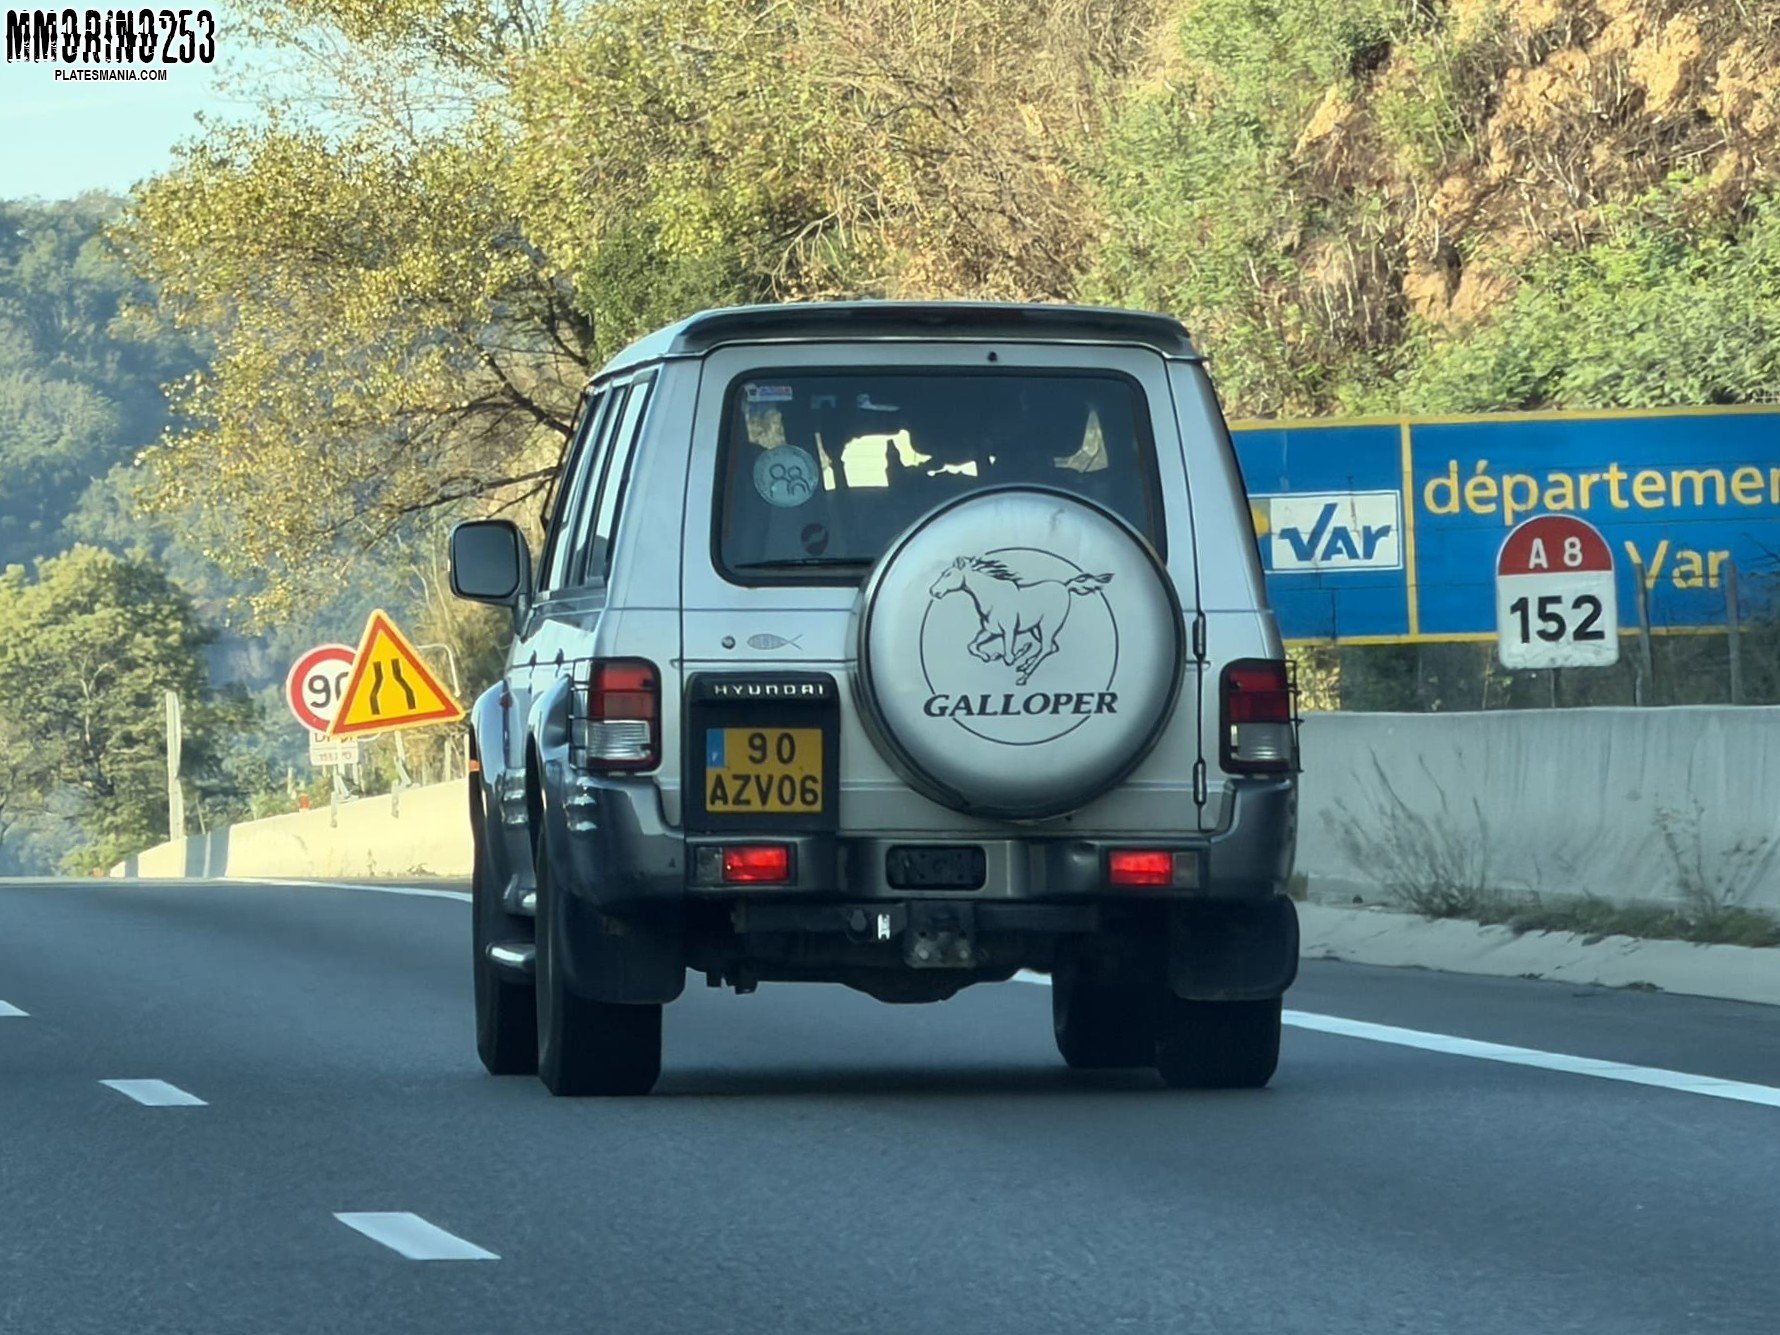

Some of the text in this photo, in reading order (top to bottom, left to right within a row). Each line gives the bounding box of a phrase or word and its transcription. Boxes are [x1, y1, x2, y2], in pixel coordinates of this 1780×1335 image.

[1424, 459, 1780, 526] départeme
[1528, 536, 1583, 569] A 8
[1624, 540, 1730, 589] Var
[1510, 594, 1606, 643] 152
[714, 684, 824, 695] HYUNDAI
[923, 692, 1119, 717] GALLOPER
[748, 732, 796, 765] 90
[709, 774, 819, 807] AZV06
